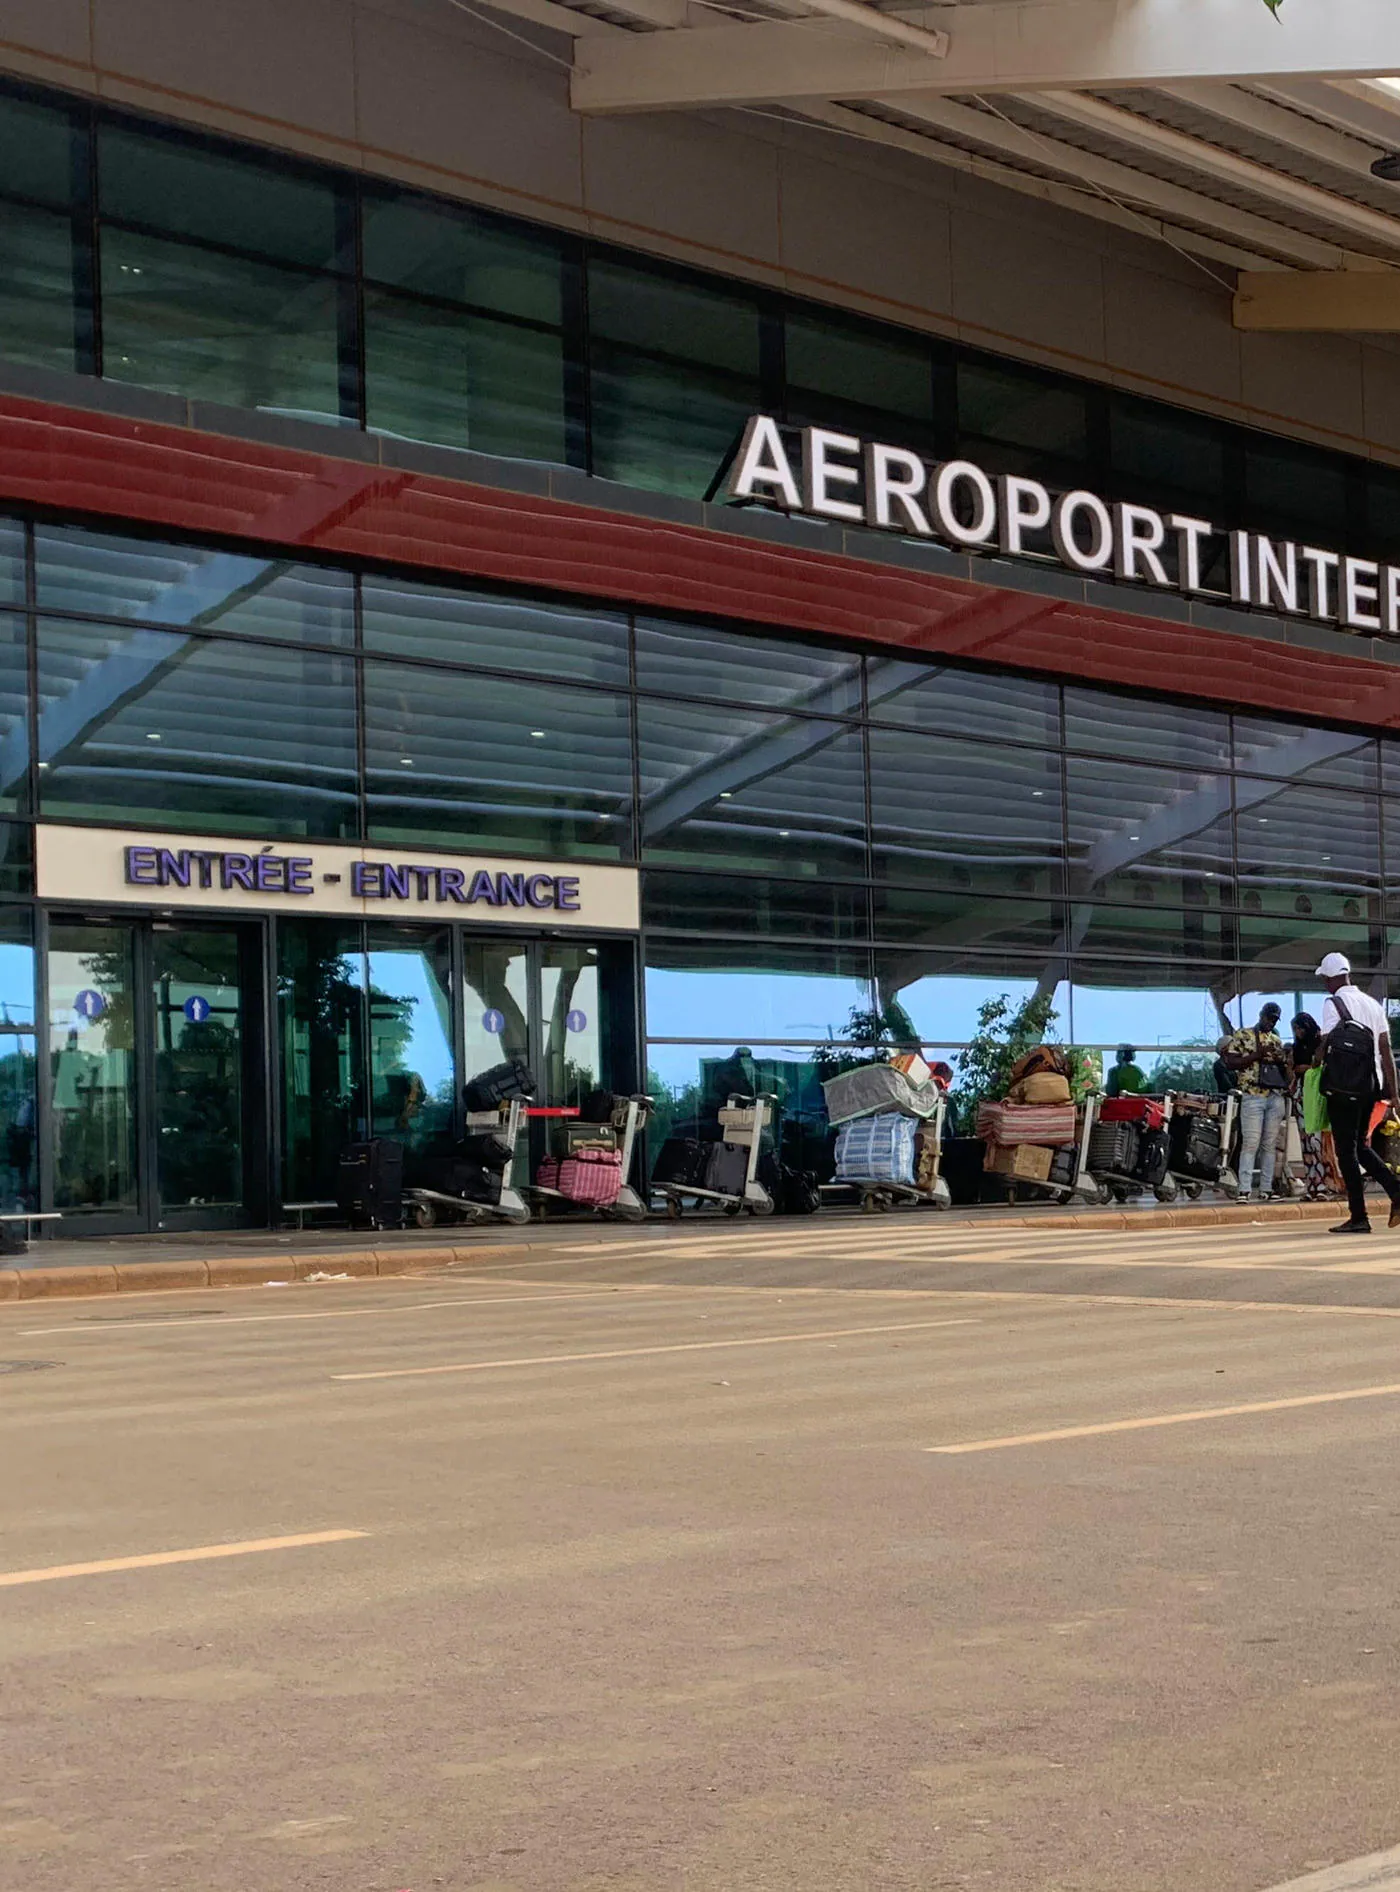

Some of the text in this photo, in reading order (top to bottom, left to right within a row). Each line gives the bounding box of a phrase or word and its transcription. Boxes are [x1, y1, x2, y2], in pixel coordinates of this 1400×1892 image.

[730, 415, 1212, 590] AEROPORT
[125, 845, 314, 895] ENTRÉE
[351, 860, 581, 911] ENTRANCE
